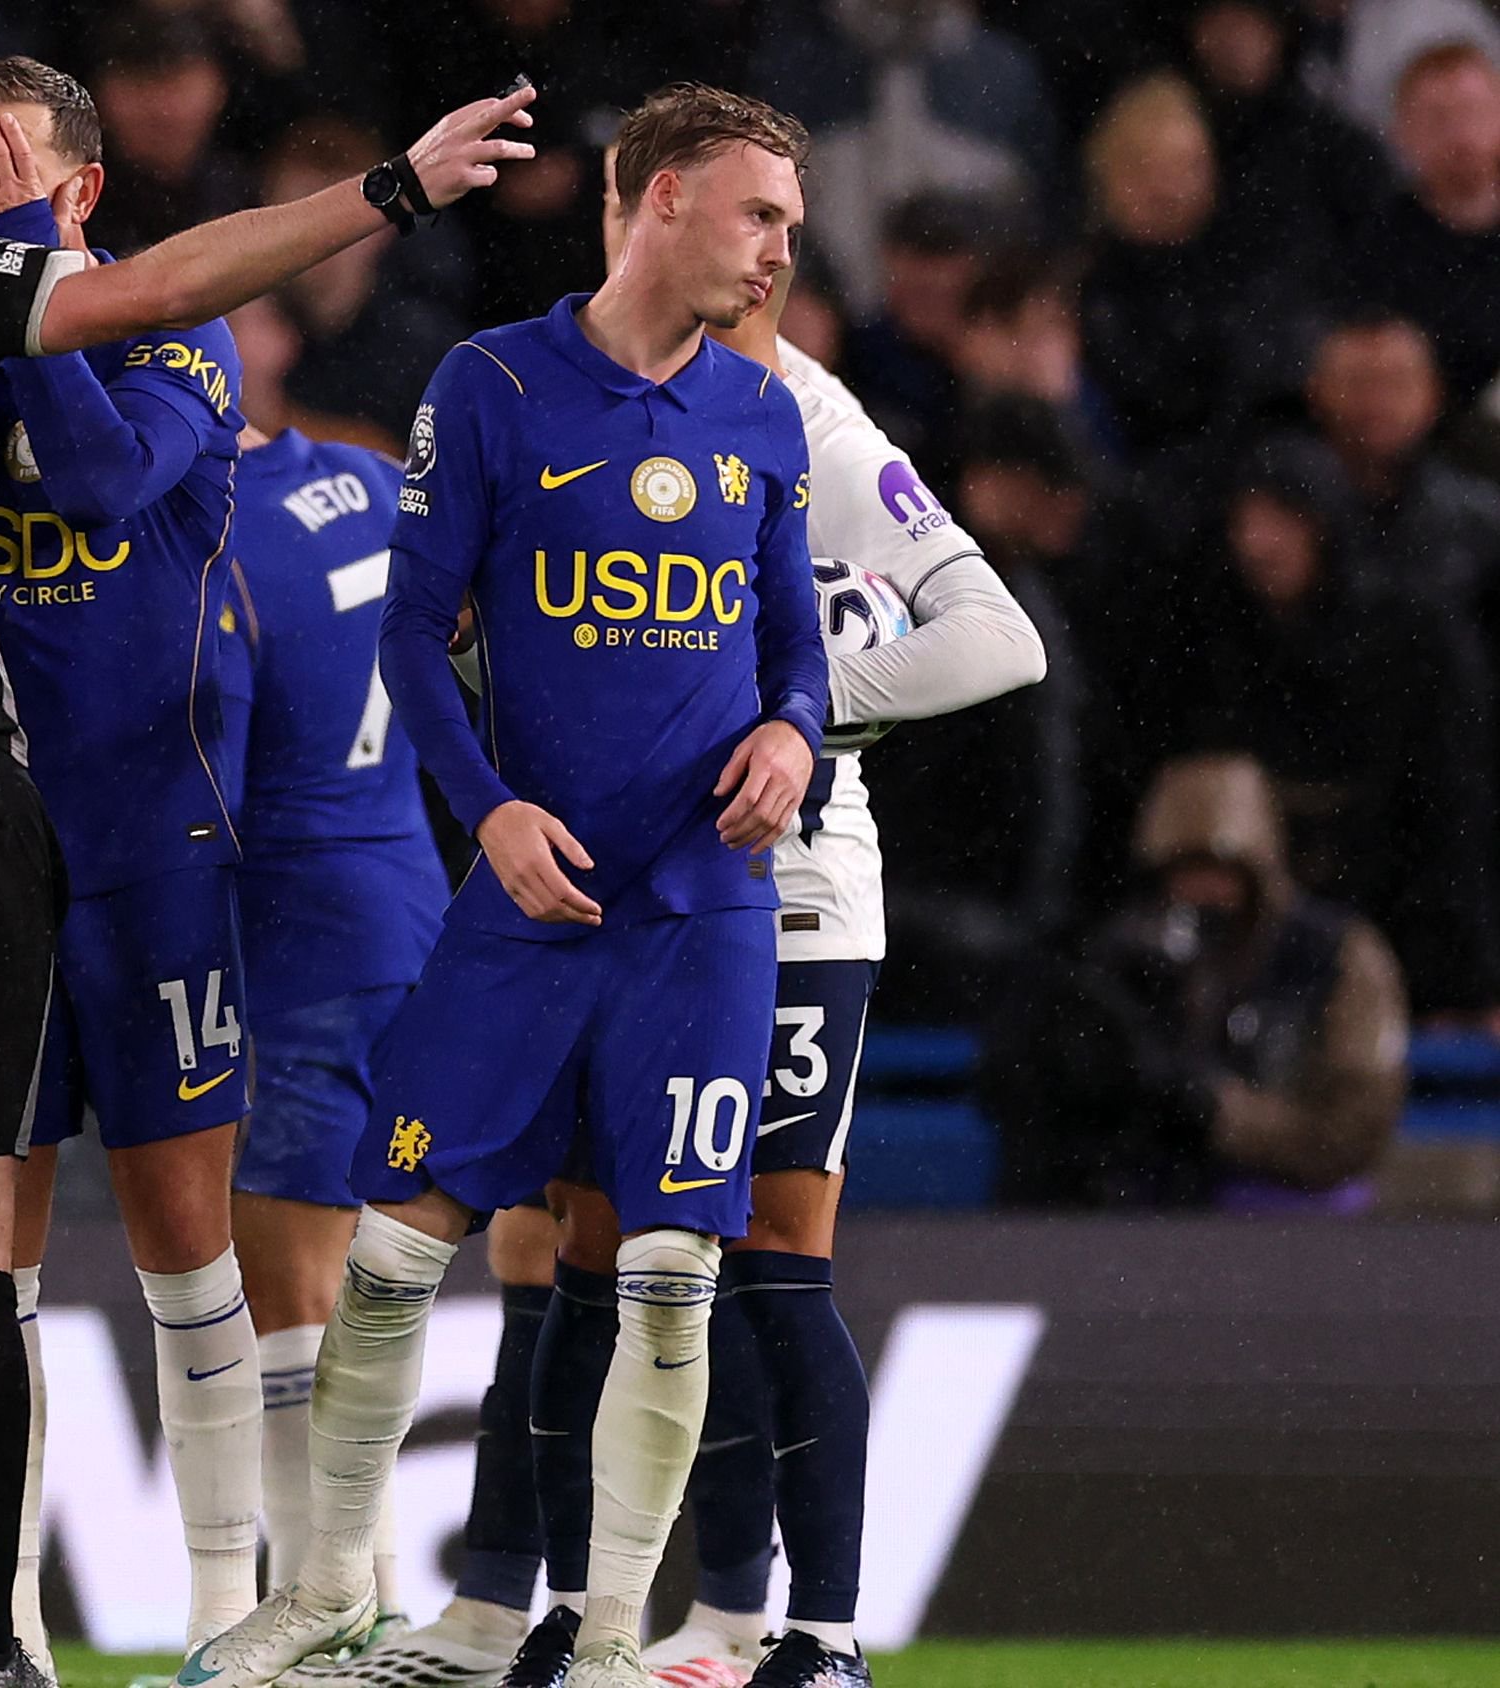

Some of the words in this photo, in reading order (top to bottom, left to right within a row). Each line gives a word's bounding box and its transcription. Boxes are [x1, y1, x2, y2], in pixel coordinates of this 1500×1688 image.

[124, 342, 231, 417] SOKIN
[283, 473, 370, 532] NETO
[650, 505, 677, 516] FIFA
[12, 581, 96, 605] CIRCLE
[535, 550, 746, 625] USDC
[606, 627, 635, 647] BY
[642, 628, 719, 650] CIRCLE
[158, 969, 241, 1070] 14
[664, 1077, 749, 1172] 10
